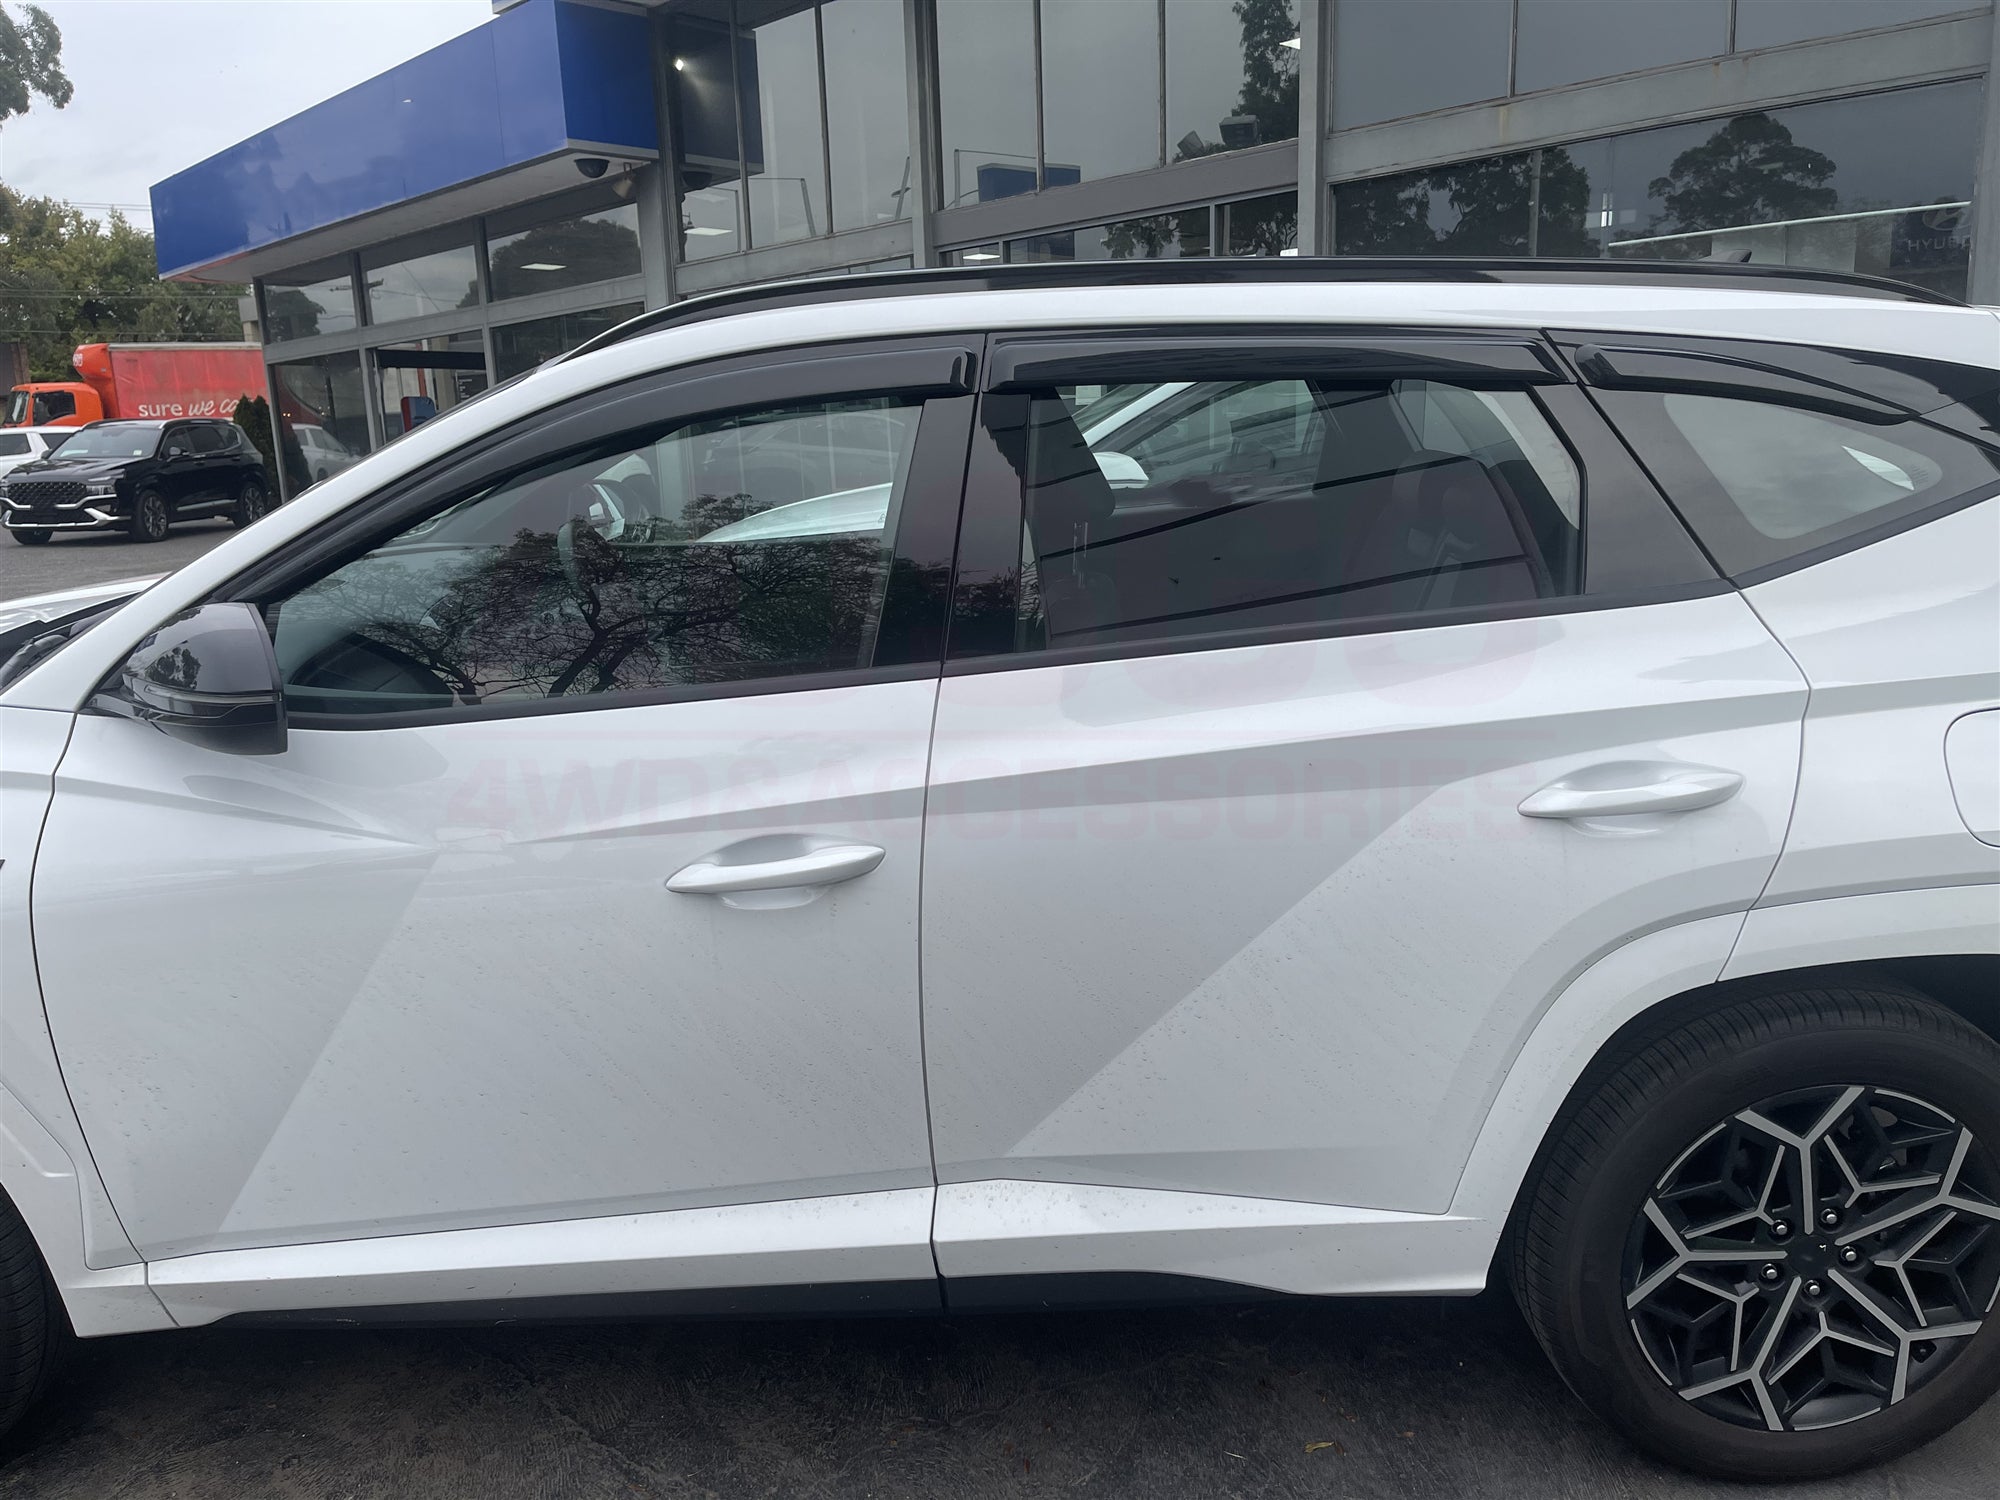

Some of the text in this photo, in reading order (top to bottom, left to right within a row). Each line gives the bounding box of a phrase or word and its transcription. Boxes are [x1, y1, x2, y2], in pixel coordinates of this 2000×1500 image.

[138, 398, 248, 417] sure we ca
